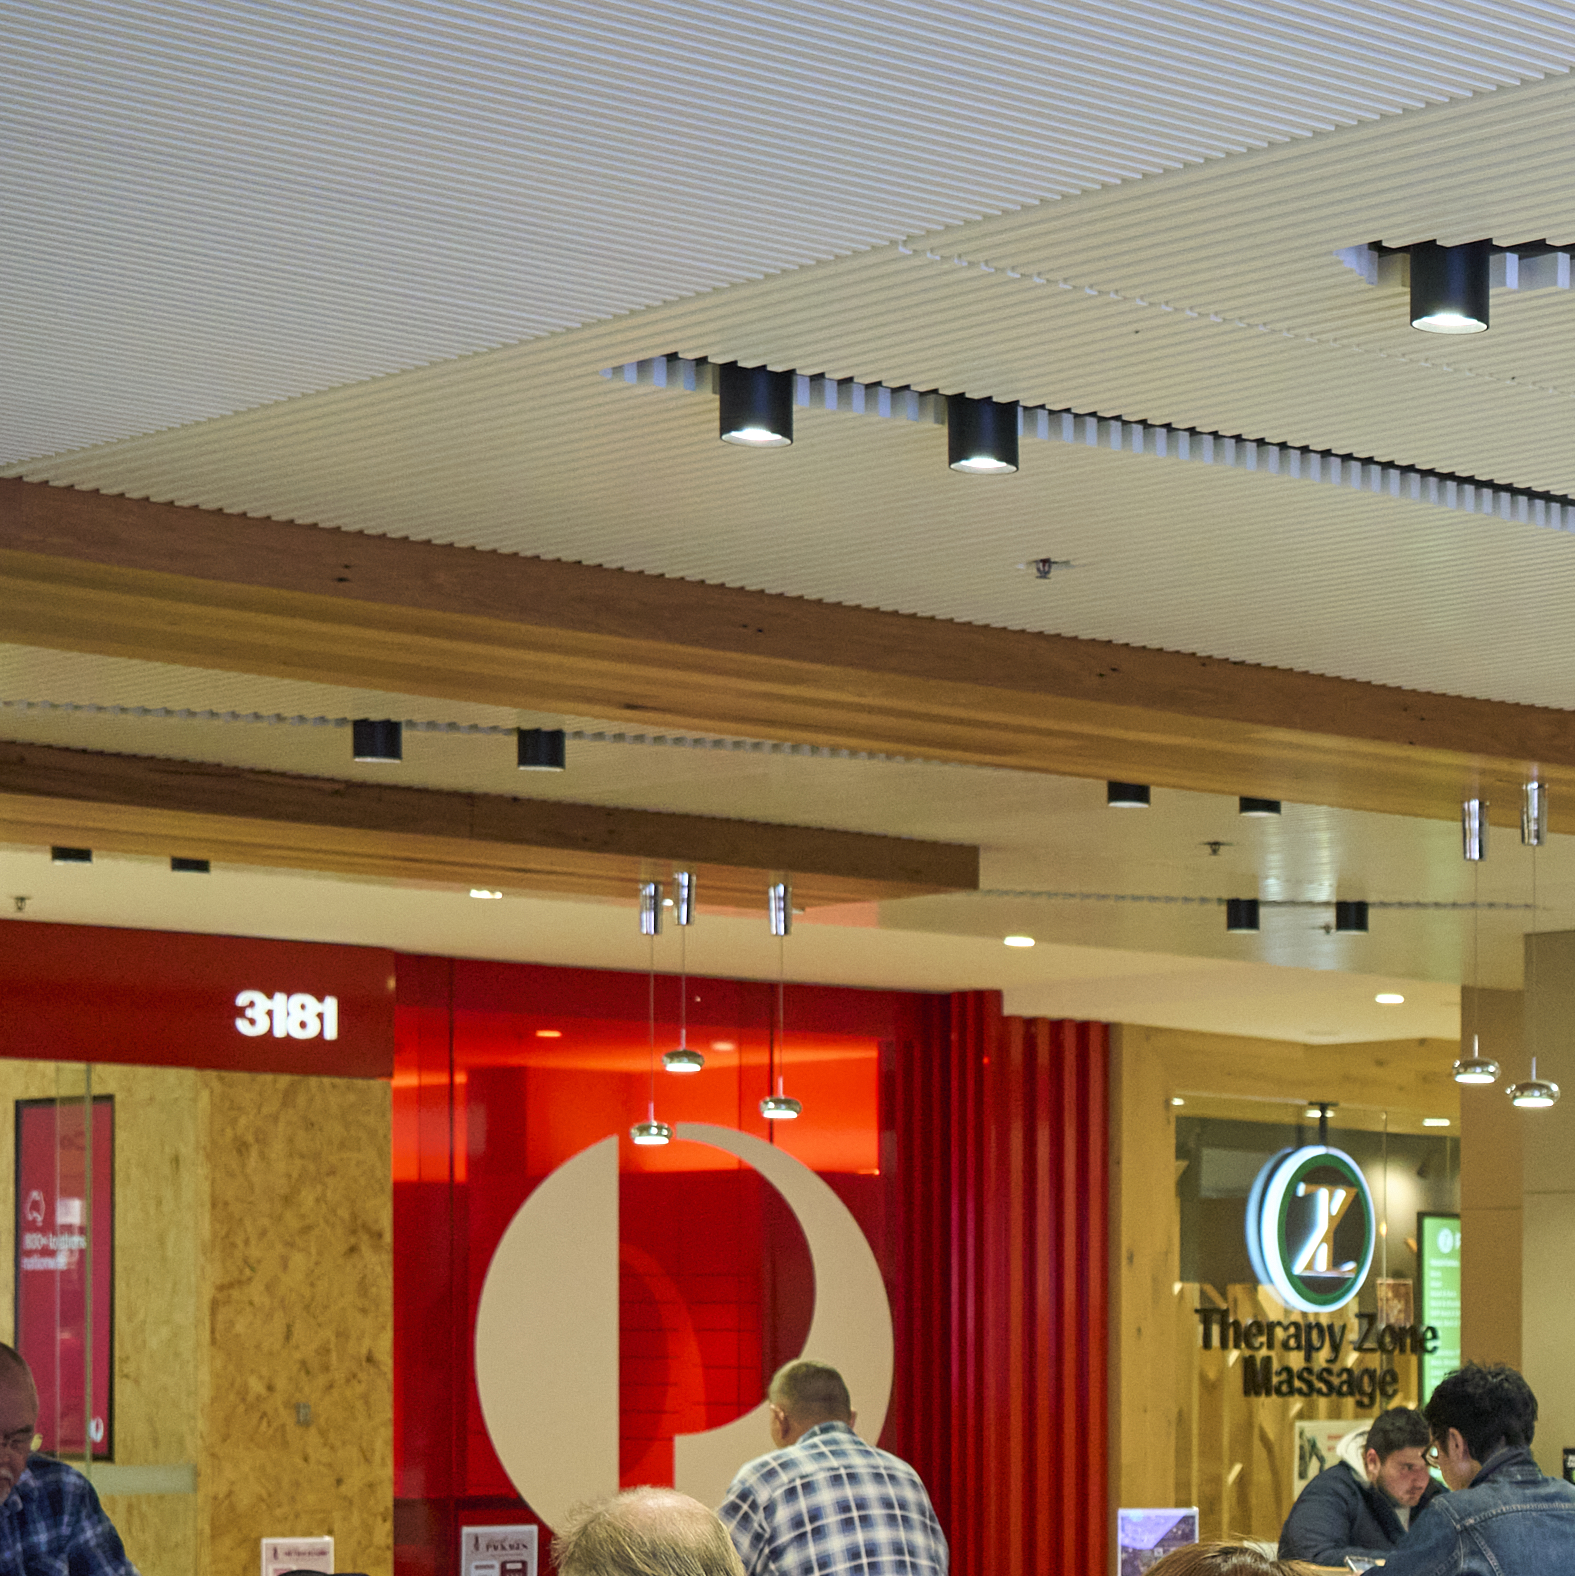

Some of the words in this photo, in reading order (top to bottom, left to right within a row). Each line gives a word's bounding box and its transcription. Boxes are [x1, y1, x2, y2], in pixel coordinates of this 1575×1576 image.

[235, 990, 338, 1040] 3181
[1194, 1308, 1347, 1364] Therapy
[1353, 1312, 1441, 1355] Zone
[1242, 1355, 1400, 1410] Massage
